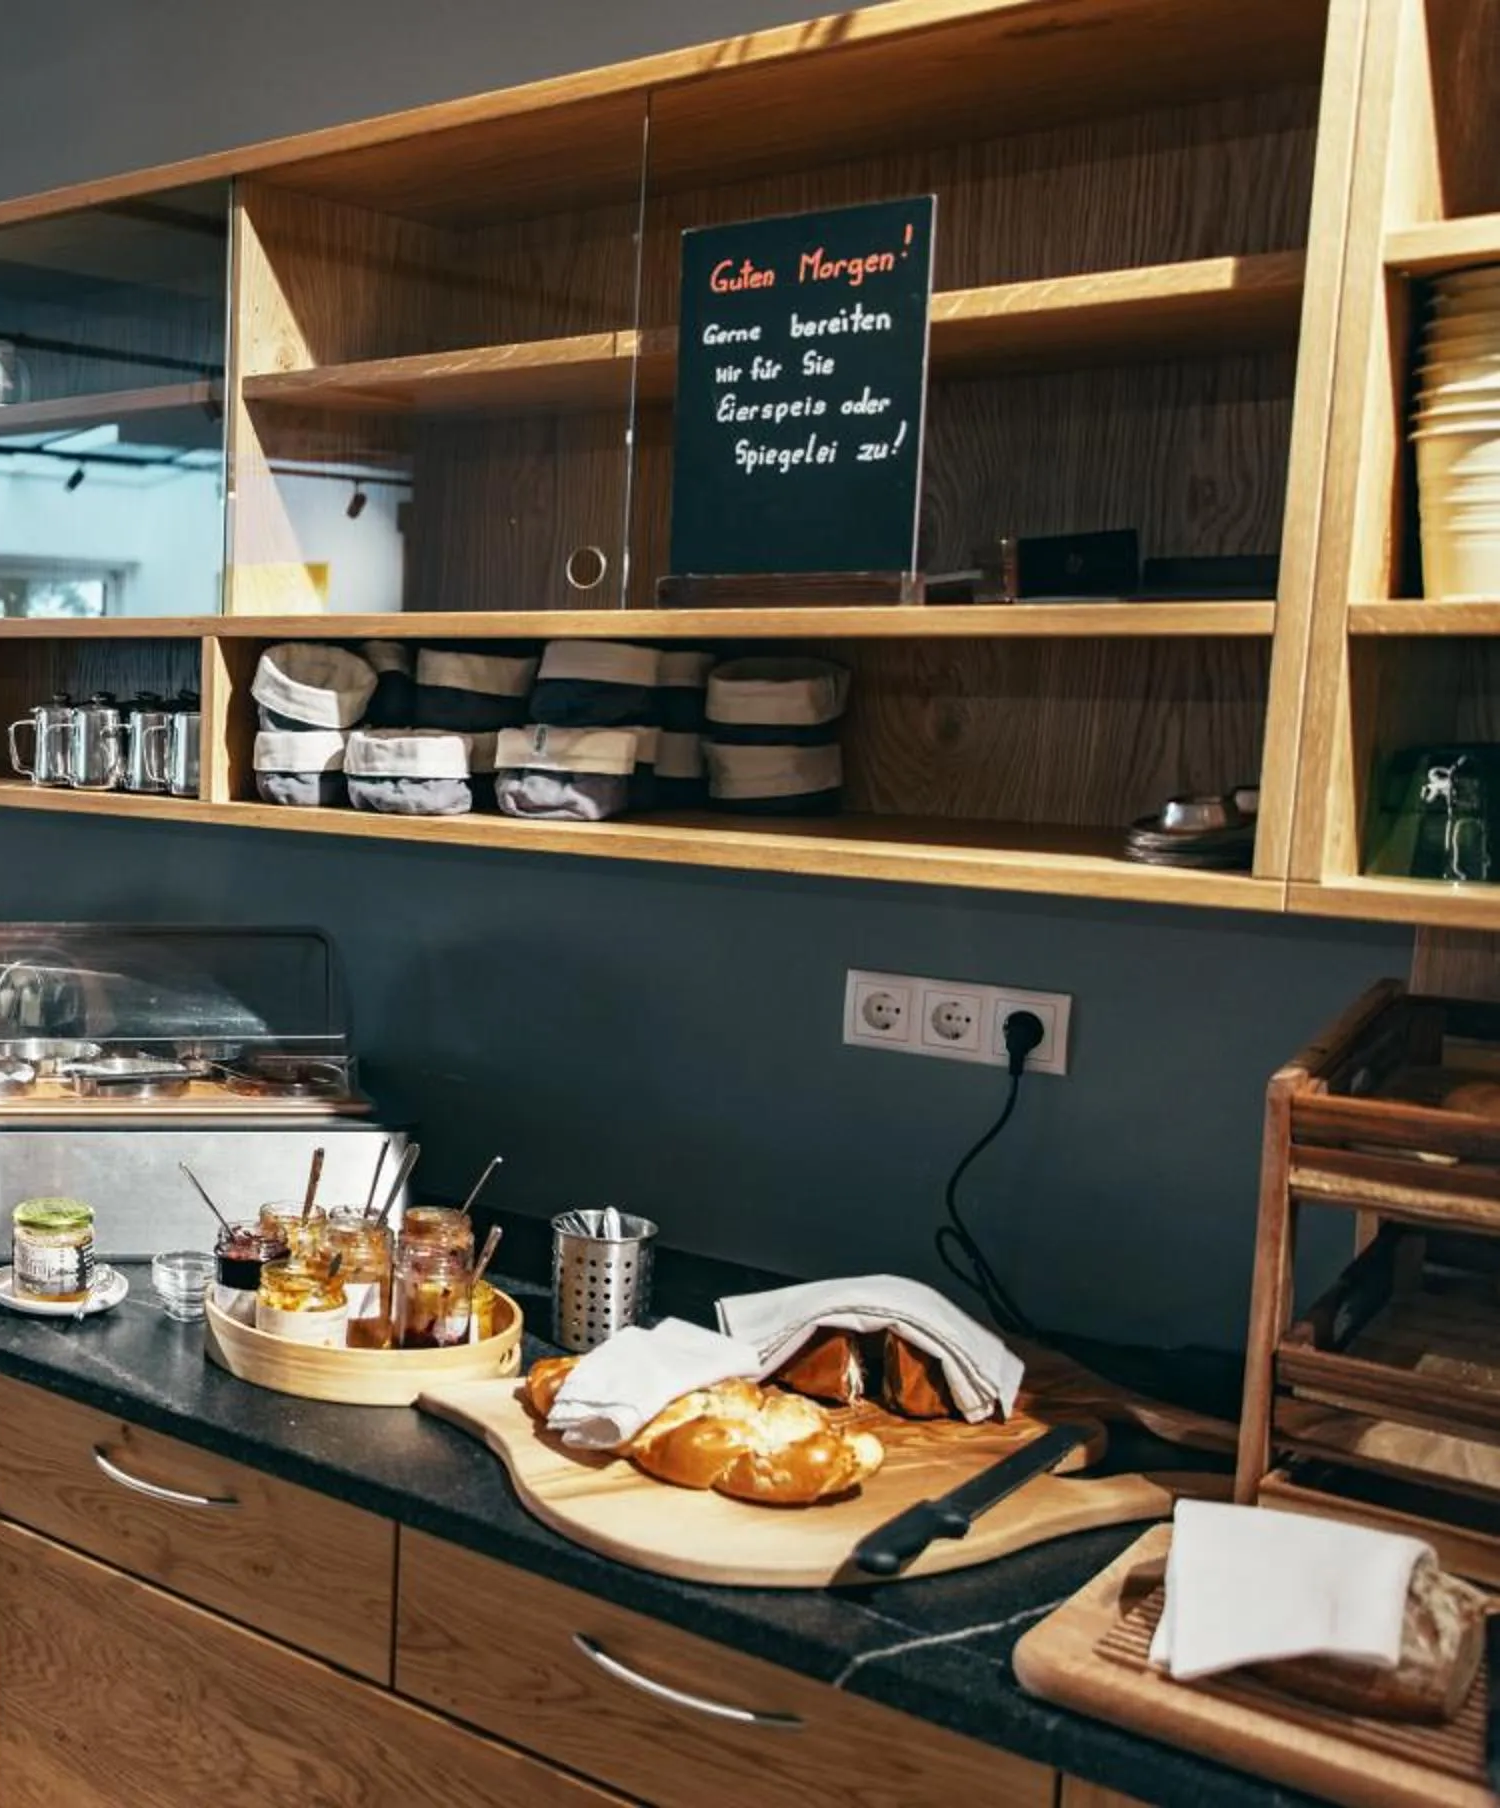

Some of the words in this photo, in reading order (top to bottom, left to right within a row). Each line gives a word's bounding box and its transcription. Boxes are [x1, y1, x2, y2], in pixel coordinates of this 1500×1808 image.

[710, 259, 775, 293] Guten
[702, 323, 762, 345] Gerne
[789, 302, 892, 339] bereiten
[749, 355, 783, 381] für
[802, 349, 835, 376] Sie
[716, 392, 827, 424] Eierspeis
[840, 385, 892, 415] oder
[734, 432, 839, 475] Spiegelei
[855, 419, 908, 462] zu!
